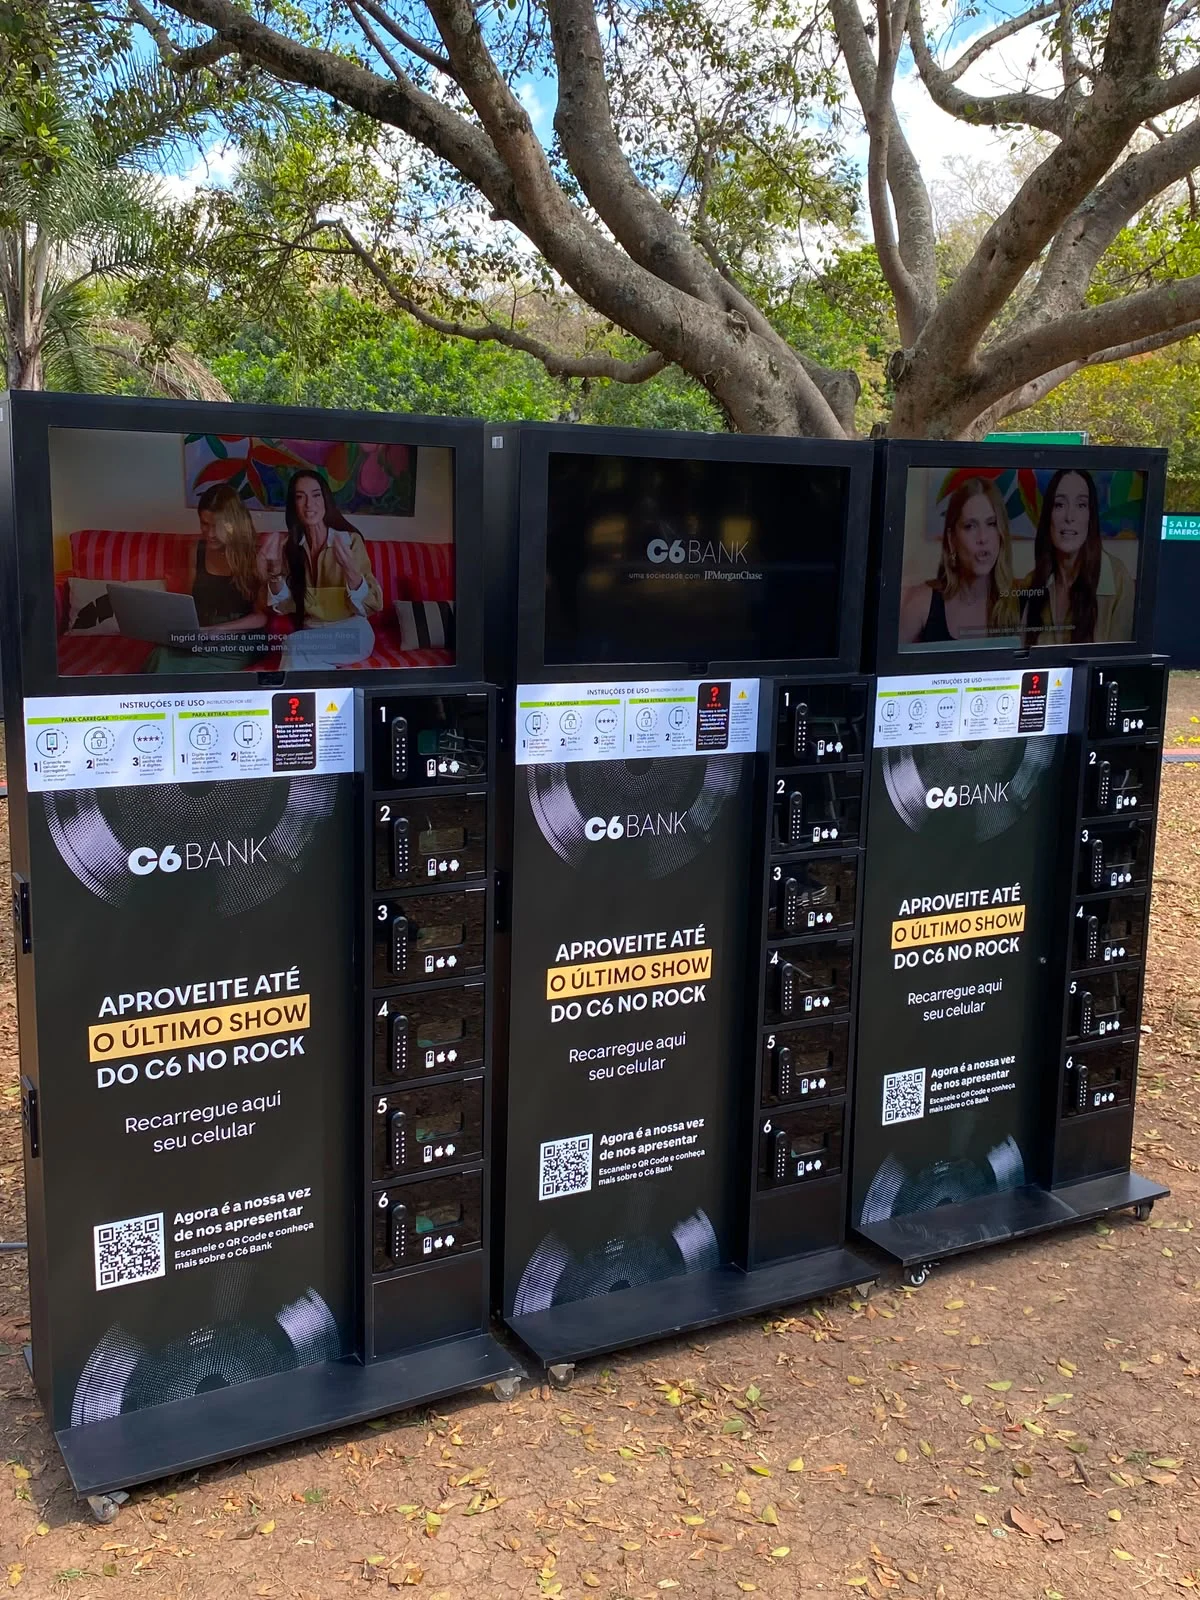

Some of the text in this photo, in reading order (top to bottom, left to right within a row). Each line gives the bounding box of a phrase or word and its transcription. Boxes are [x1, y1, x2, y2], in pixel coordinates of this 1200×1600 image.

[647, 539, 748, 563] C6 BANK
[646, 571, 682, 579] sociedade
[704, 571, 762, 581] JPMorganChase
[171, 633, 195, 643] Ingrid
[198, 633, 208, 641] foi
[211, 633, 239, 641] assistir
[268, 634, 287, 643] peça
[239, 645, 254, 653] que
[1099, 673, 1103, 684] 1
[120, 700, 171, 709] INSTRUÇÕES
[175, 699, 184, 707] DE
[785, 693, 789, 706] 1
[380, 707, 386, 722] 1
[1089, 752, 1096, 764] 2
[777, 780, 784, 793] 2
[926, 782, 1009, 809] C6 BANK
[380, 806, 390, 821] 2
[585, 811, 687, 841] C6 BANK
[1082, 830, 1088, 842] 3
[128, 837, 267, 875] C6 BANK
[773, 867, 781, 880] 3
[899, 883, 1021, 915] APROVEITE ATÉ
[378, 905, 387, 921] 3
[1077, 906, 1083, 918] 4
[895, 912, 1023, 942] O ÚLTIMO SHOW
[555, 924, 705, 961] APROVEITE ATÉ
[894, 937, 1019, 969] DO C6 NO ROCK
[770, 951, 778, 964] 4
[551, 957, 709, 992] O ÚLTIMO SHOW
[98, 966, 300, 1017] APROVEITE ATÉ
[908, 979, 1002, 1005] Recarregue aqui
[1070, 982, 1076, 993] 5
[378, 1001, 388, 1016] 4
[551, 985, 706, 1022] DO C6 NO ROCK
[923, 1001, 985, 1021] seu celular
[94, 1003, 306, 1052] O ÚLTIMO SHOW
[569, 1032, 686, 1063] Recarregue aqui
[767, 1035, 775, 1048] 5
[97, 1036, 305, 1088] DO C6 NO ROCK
[589, 1057, 665, 1080] seu celular
[931, 1066, 958, 1078] Agora
[960, 1063, 965, 1072] é
[974, 1058, 999, 1069] nossa
[1001, 1056, 1015, 1064] vez
[1066, 1057, 1072, 1068] 6
[931, 1069, 1009, 1091] de nos apresentar
[929, 1105, 943, 1113] mais
[944, 1101, 960, 1110] sobre
[975, 1096, 989, 1104] Bank
[930, 1094, 955, 1104] Escaneie
[961, 1090, 969, 1098] QR
[971, 1087, 986, 1096] Code
[992, 1083, 1015, 1092] conheça
[126, 1091, 281, 1133] Recarregue aqui
[377, 1098, 387, 1113] 5
[153, 1122, 256, 1152] seu celular
[600, 1132, 634, 1145] Agora
[636, 1127, 643, 1138] é
[653, 1122, 684, 1135] nossa
[687, 1119, 704, 1128] vez
[763, 1120, 771, 1133] 6
[600, 1134, 697, 1160] de nos apresentar
[599, 1163, 630, 1175] Escaneie
[638, 1159, 648, 1167] QR
[650, 1155, 668, 1165] Code
[675, 1149, 705, 1160] conheça
[599, 1175, 615, 1185] mais
[617, 1171, 637, 1181] sobre
[644, 1168, 654, 1176] C6
[656, 1164, 672, 1174] Bank
[174, 1188, 311, 1225] Agora é a nossa vez
[378, 1192, 388, 1208] 6
[174, 1206, 303, 1242] de nos apresentar
[175, 1243, 216, 1258] Escaneie
[226, 1238, 240, 1247] QR
[242, 1232, 267, 1244] Code
[276, 1222, 314, 1236] conheça
[175, 1260, 197, 1270] mais
[199, 1254, 225, 1265] sobre
[235, 1247, 248, 1256] C6
[250, 1241, 272, 1253] Bank
